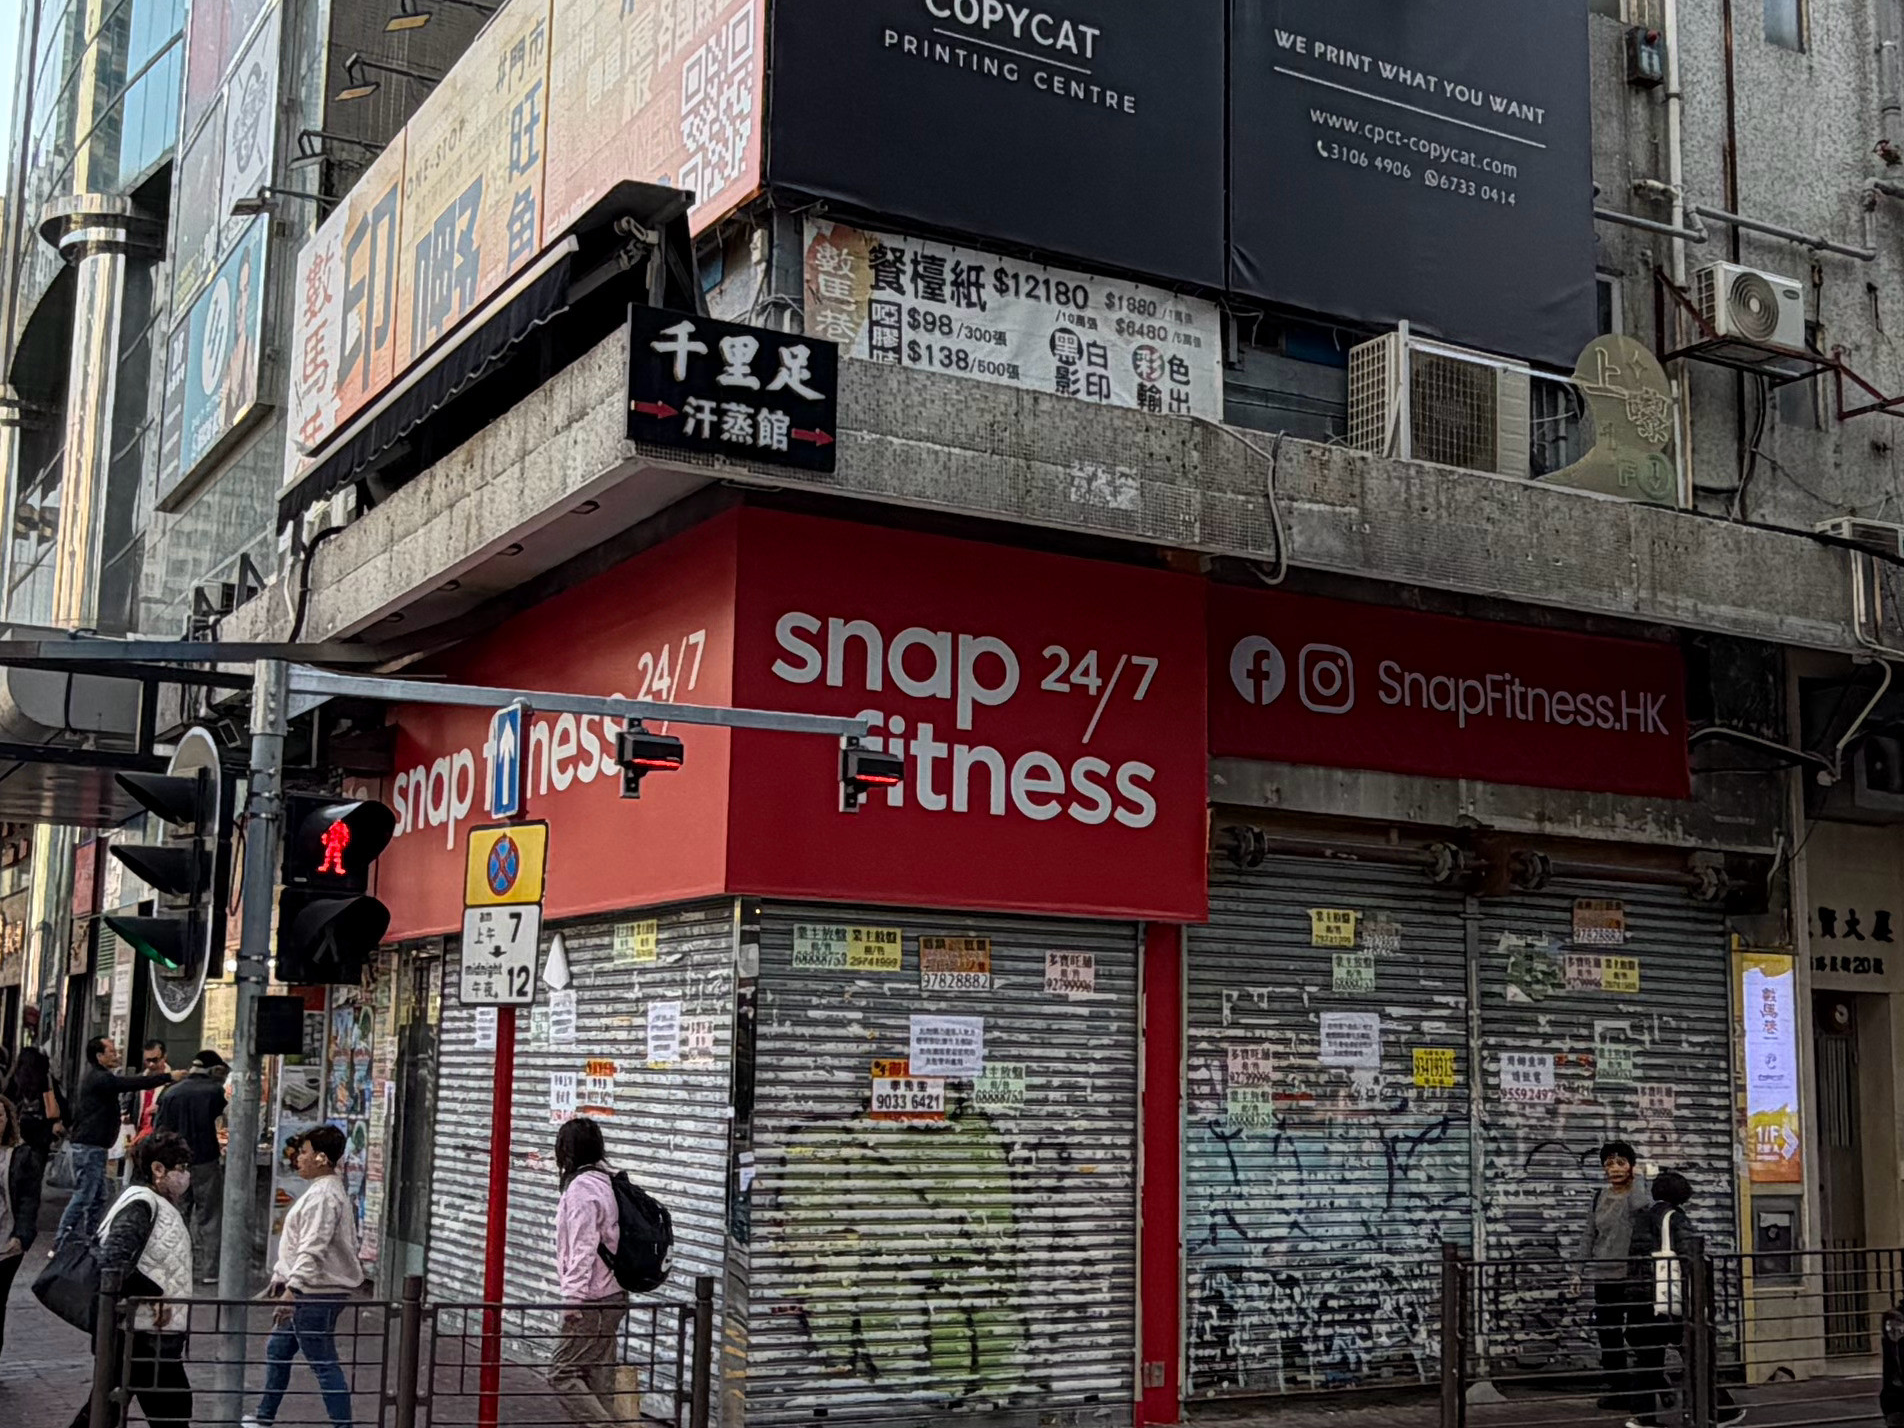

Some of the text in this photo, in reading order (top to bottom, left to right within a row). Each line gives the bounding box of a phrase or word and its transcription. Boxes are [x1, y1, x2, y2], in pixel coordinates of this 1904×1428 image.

[885, 29, 1135, 113] PRINTING CENTRE
[1274, 28, 1545, 124] WE PRINT WHAT YOU WANT
[406, 118, 466, 200] ONE-STOP
[1310, 108, 1517, 178] www.cpct-copycat.com
[1329, 143, 1369, 167] 3106
[1374, 156, 1412, 179] 4906
[1440, 174, 1476, 196] 6733
[508, 78, 543, 272] 旺角
[868, 243, 987, 312] 餐檯紙
[993, 266, 1089, 310] $12180
[1105, 291, 1157, 317] $1880
[907, 307, 954, 336] $98
[650, 320, 826, 400] 千里足
[907, 340, 970, 371] $138
[683, 396, 790, 451] 汗蒸館
[772, 611, 1158, 744] snap 24/7
[1378, 660, 1669, 736] SnapFitness.HK
[392, 748, 475, 851] snap
[483, 693, 626, 812] fness
[474, 927, 495, 944] 上午
[509, 912, 522, 943] 7
[465, 963, 530, 997] midnight 12
[922, 973, 989, 990] 97828882
[876, 1093, 941, 1109] 9033 6421
